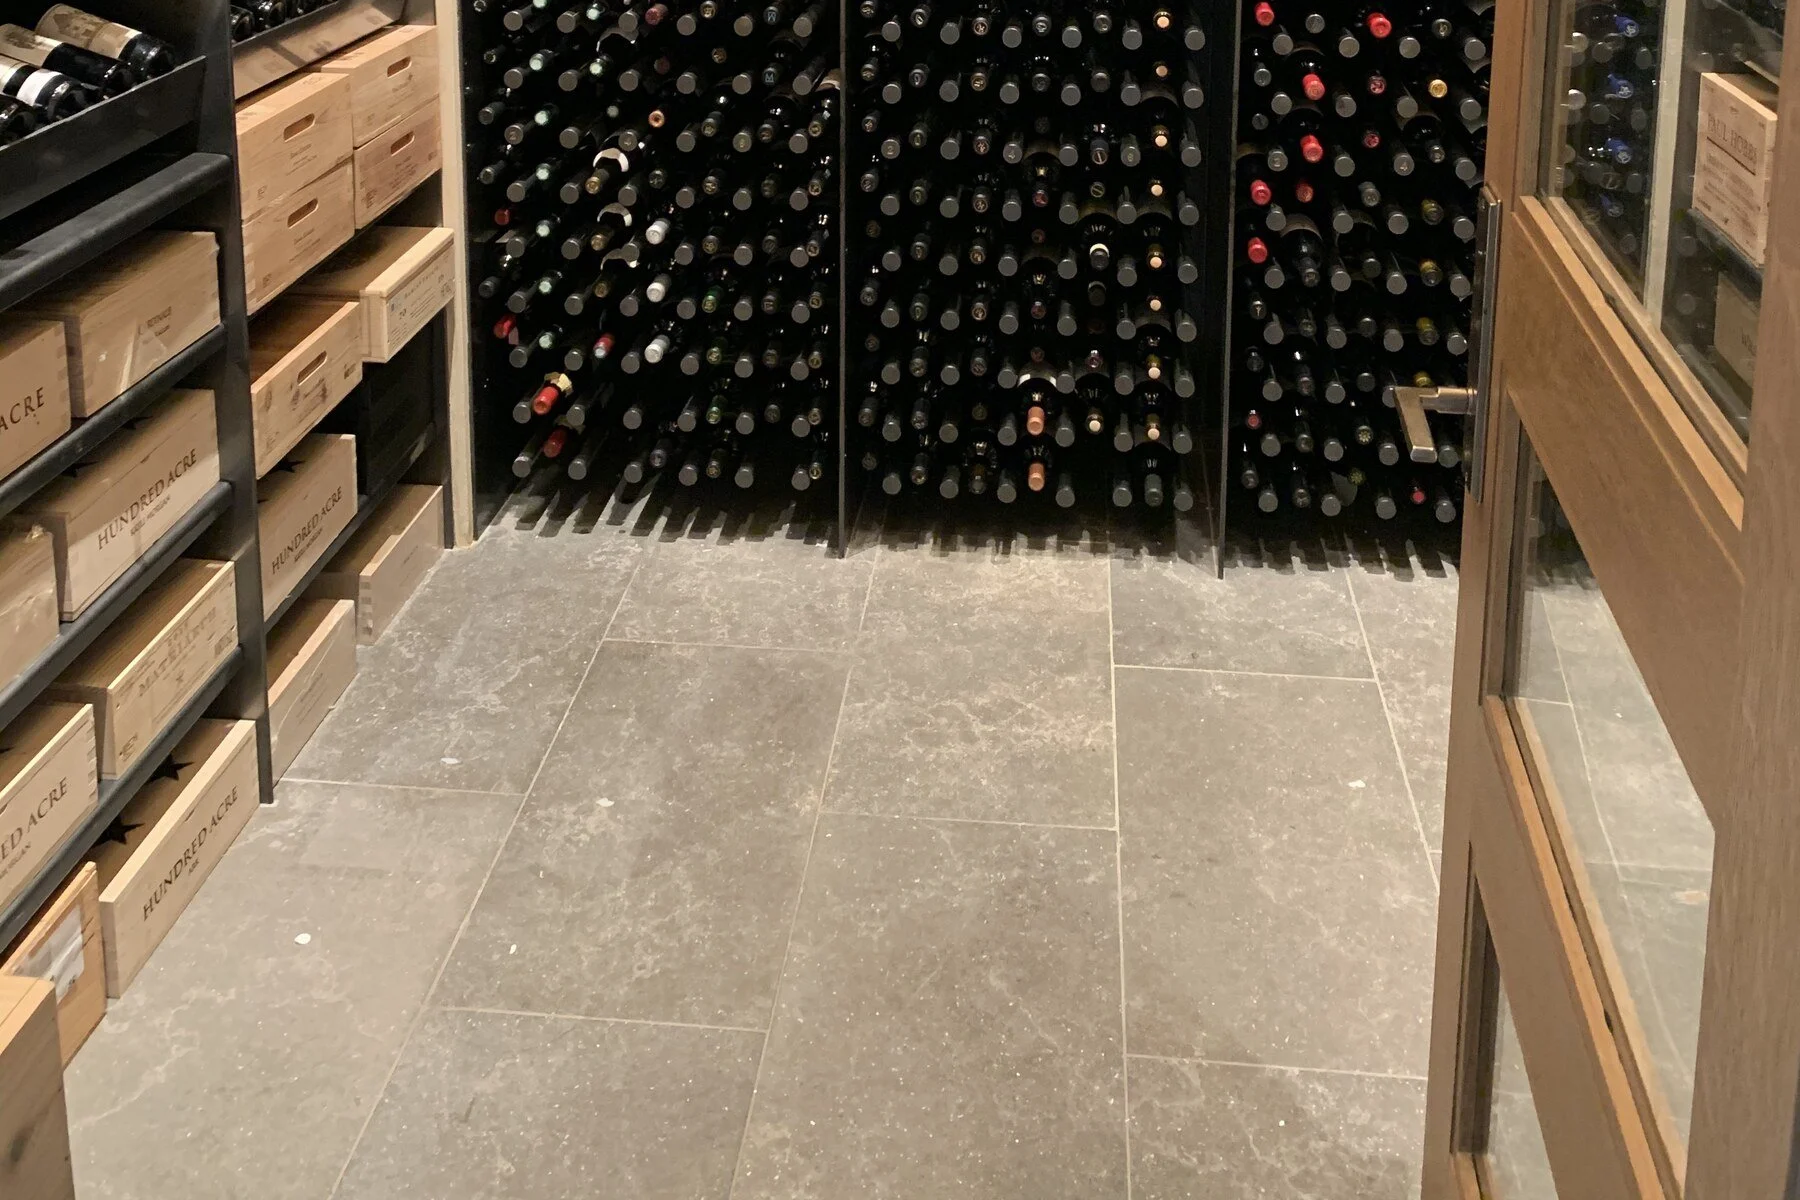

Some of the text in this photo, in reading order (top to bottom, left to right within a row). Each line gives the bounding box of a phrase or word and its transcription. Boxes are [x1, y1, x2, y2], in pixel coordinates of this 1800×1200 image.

[0, 386, 45, 431] ACRE
[98, 448, 197, 550] HUNDRED ACRE
[272, 485, 342, 575] HUNDRED ACRE
[27, 776, 68, 834] ACRE
[142, 786, 238, 922] HUNDRED ACRE
